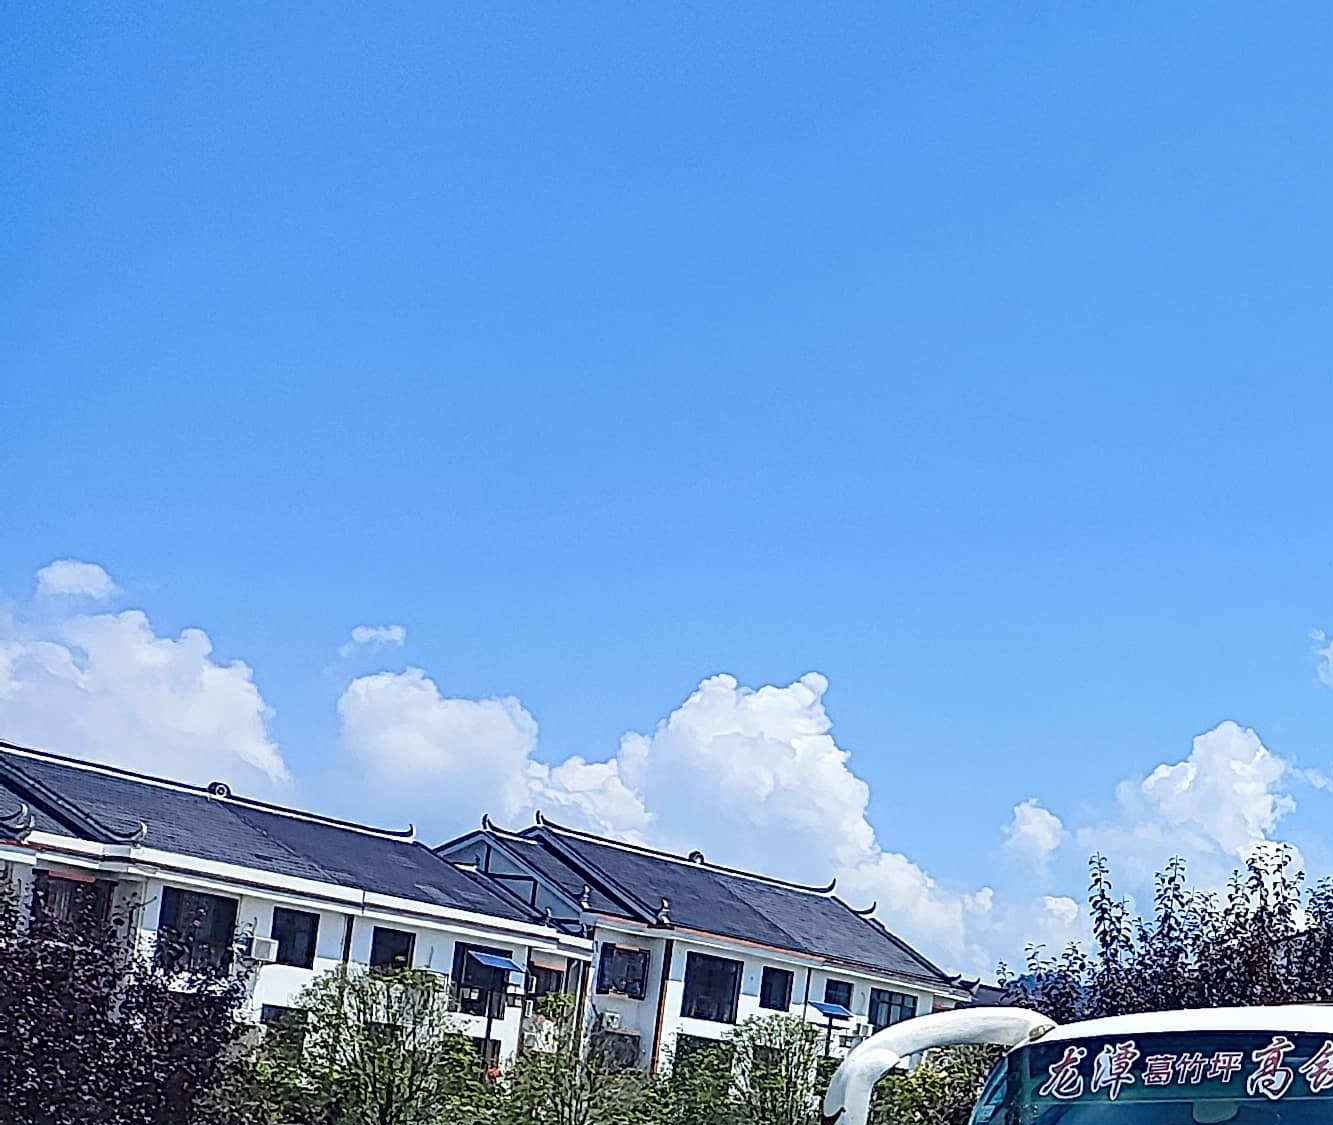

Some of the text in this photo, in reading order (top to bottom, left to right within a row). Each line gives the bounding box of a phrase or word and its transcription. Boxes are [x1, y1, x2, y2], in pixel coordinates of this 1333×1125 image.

[1038, 1040, 1140, 1101] 龙潭
[1142, 1051, 1243, 1086] 葛竹坪
